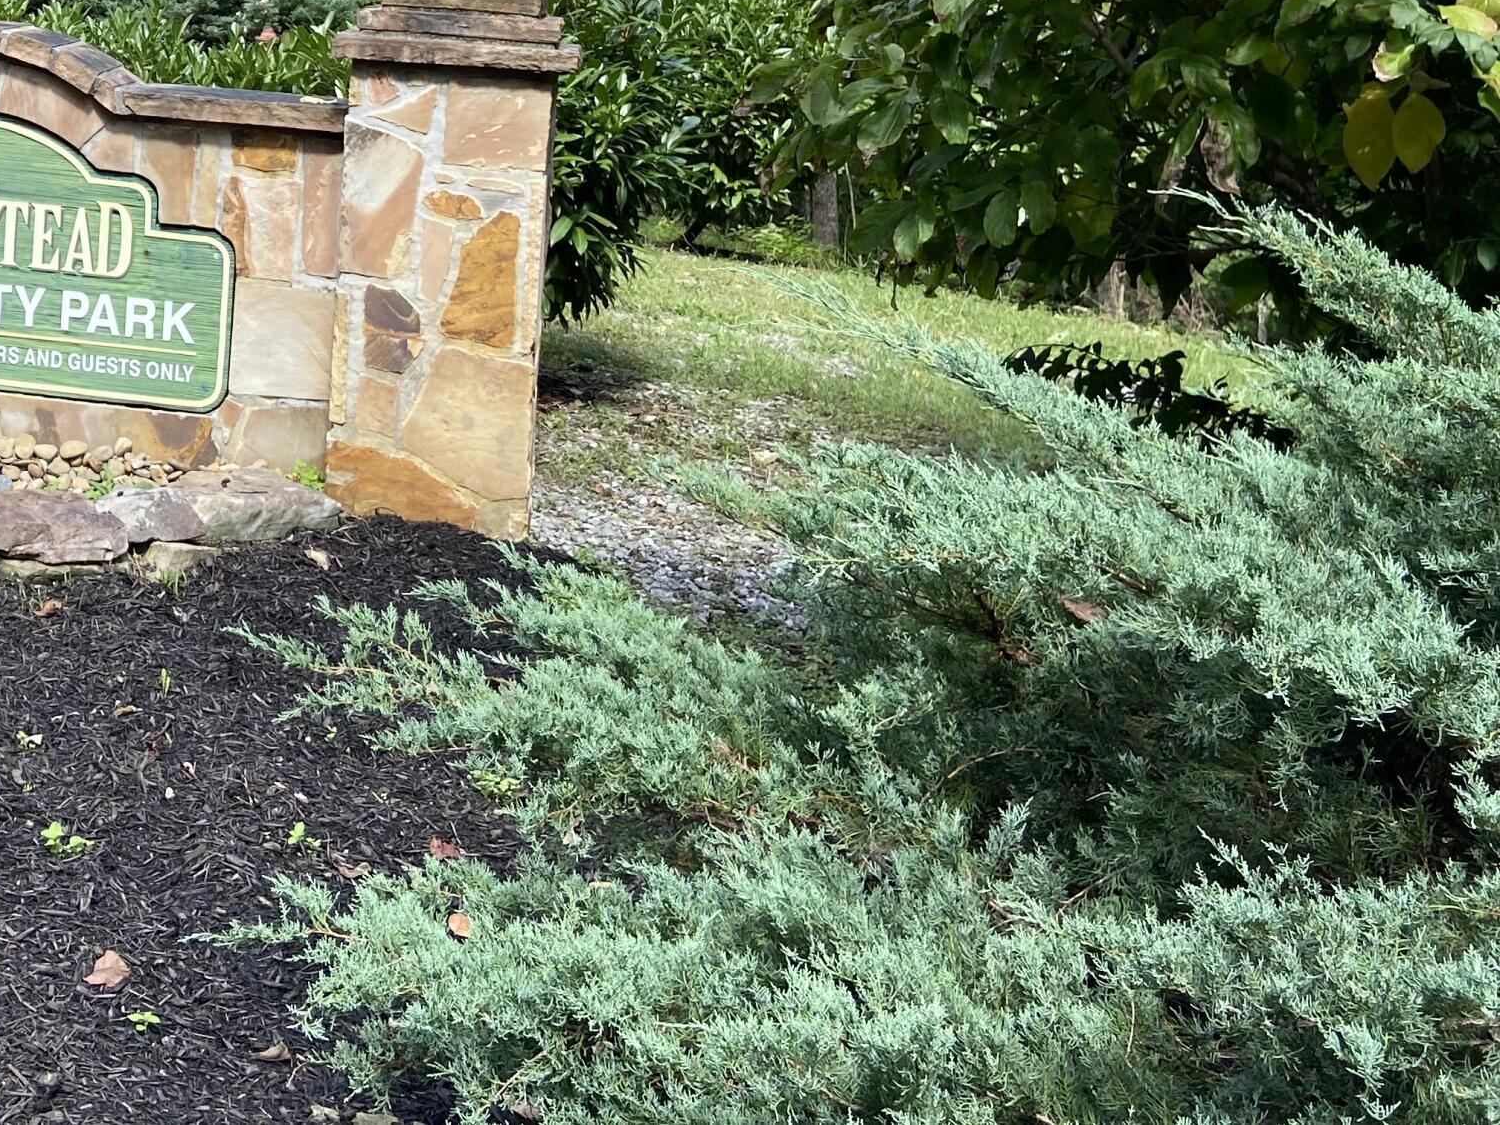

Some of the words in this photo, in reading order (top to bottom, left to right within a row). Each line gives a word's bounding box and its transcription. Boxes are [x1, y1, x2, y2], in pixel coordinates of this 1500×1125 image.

[60, 290, 197, 344] PARK
[23, 347, 63, 369] AND
[67, 351, 142, 377] GUESTS
[147, 361, 194, 382] ONLY
